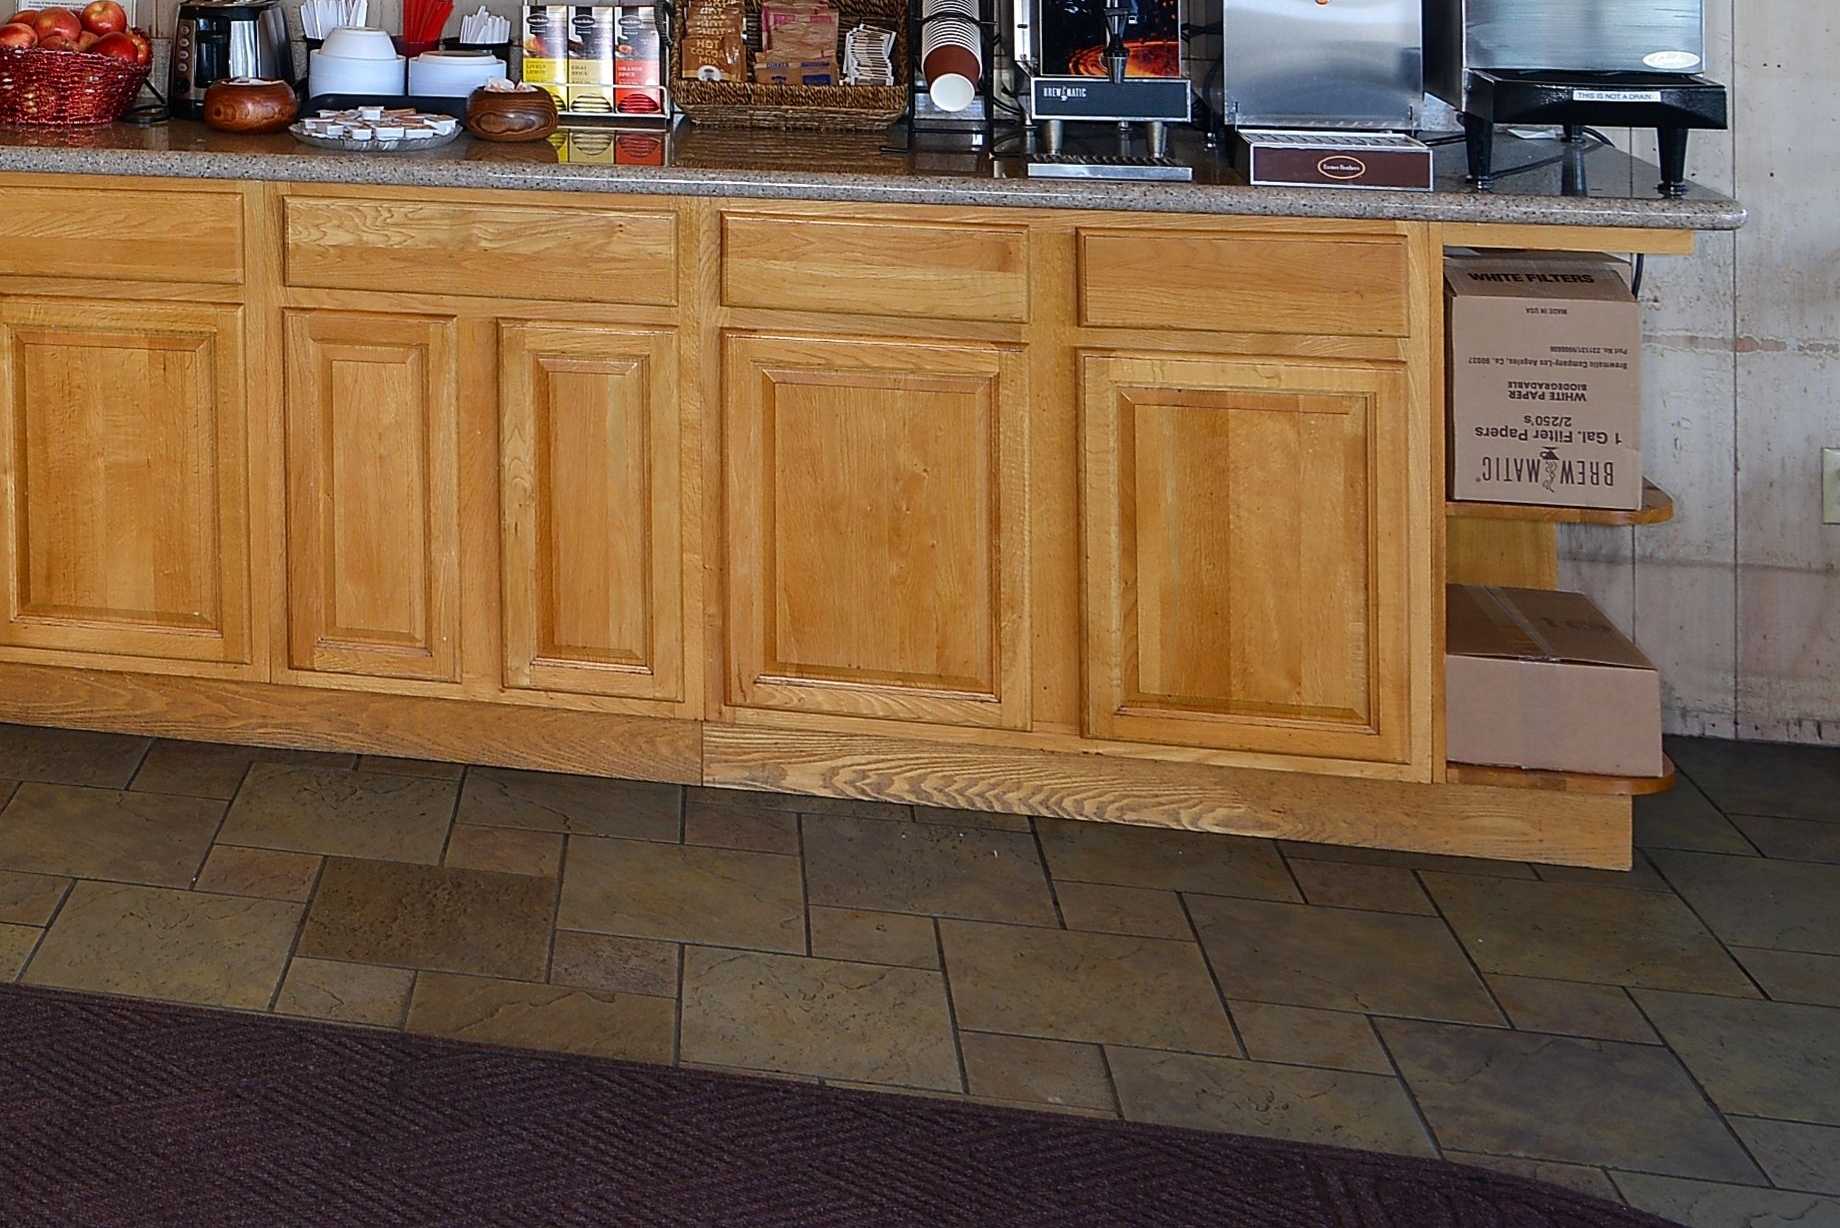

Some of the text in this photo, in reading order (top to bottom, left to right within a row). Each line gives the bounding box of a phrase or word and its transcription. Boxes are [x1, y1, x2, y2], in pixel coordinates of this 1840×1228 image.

[696, 40, 720, 49] HOT
[690, 47, 725, 58] COCOA
[698, 56, 718, 65] MIX
[1578, 92, 1595, 100] THIS
[1596, 92, 1604, 100] IS
[1468, 272, 1594, 284] WHITE FILTERS
[1508, 390, 1587, 402] WHITE PAPER
[1524, 415, 1572, 427] 2/250's
[1475, 426, 1622, 445] 1 Gal. Filter Papers
[1482, 457, 1614, 486] BREW MATIC
